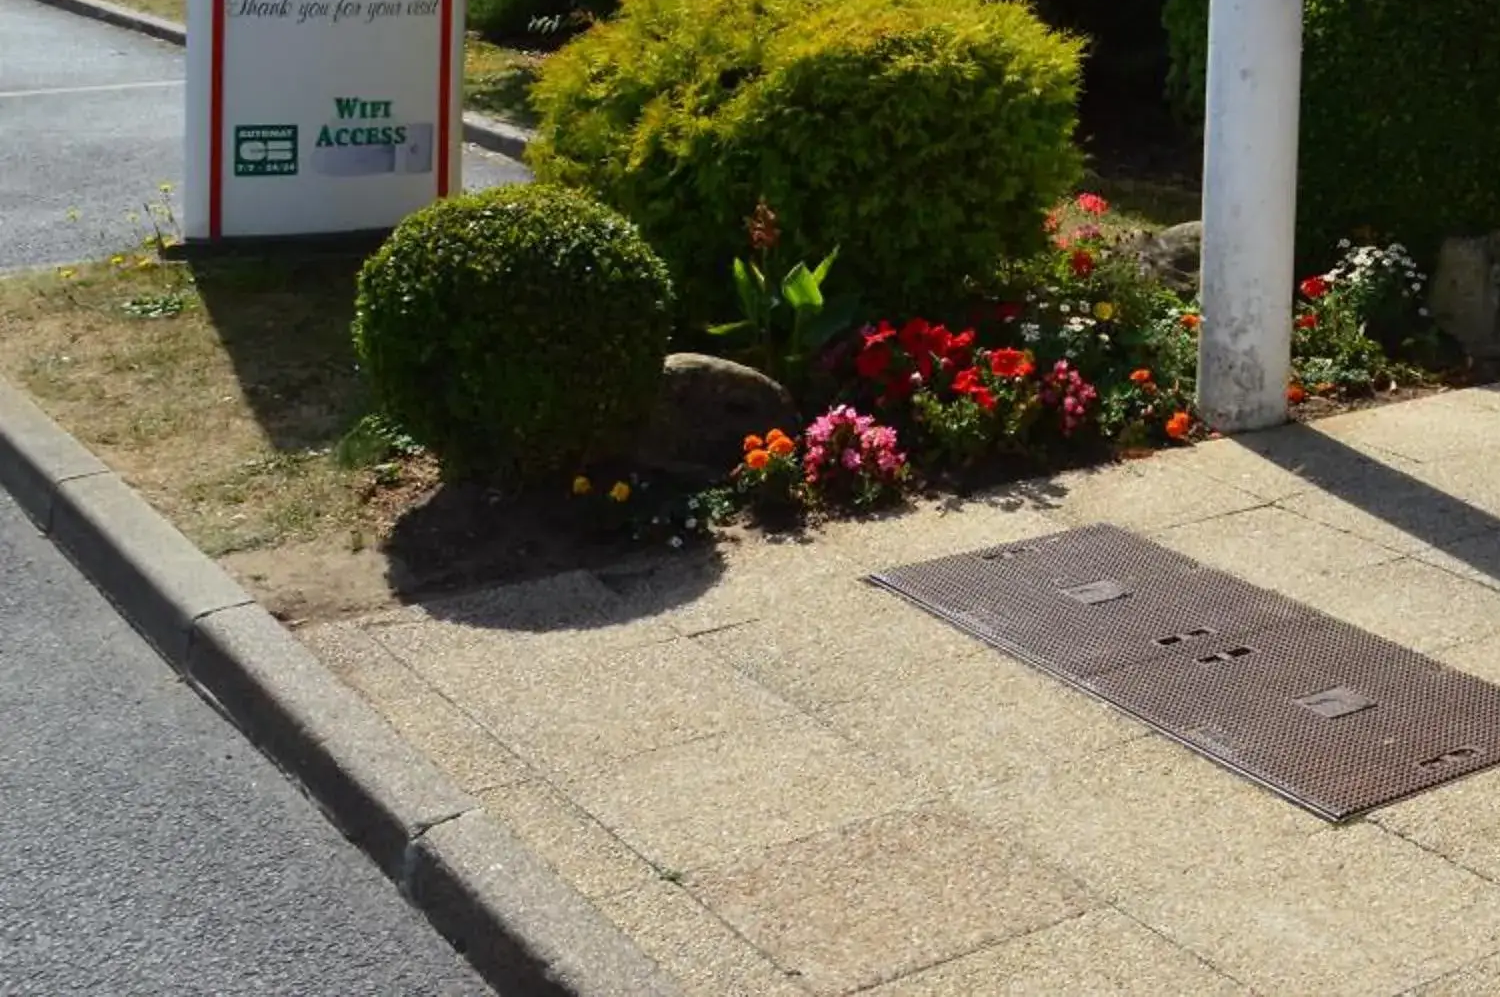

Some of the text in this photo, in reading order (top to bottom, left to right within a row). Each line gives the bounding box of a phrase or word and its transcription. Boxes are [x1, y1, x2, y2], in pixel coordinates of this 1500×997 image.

[296, 1, 329, 25] you
[367, 2, 401, 25] your
[315, 124, 408, 147] ACCESS
